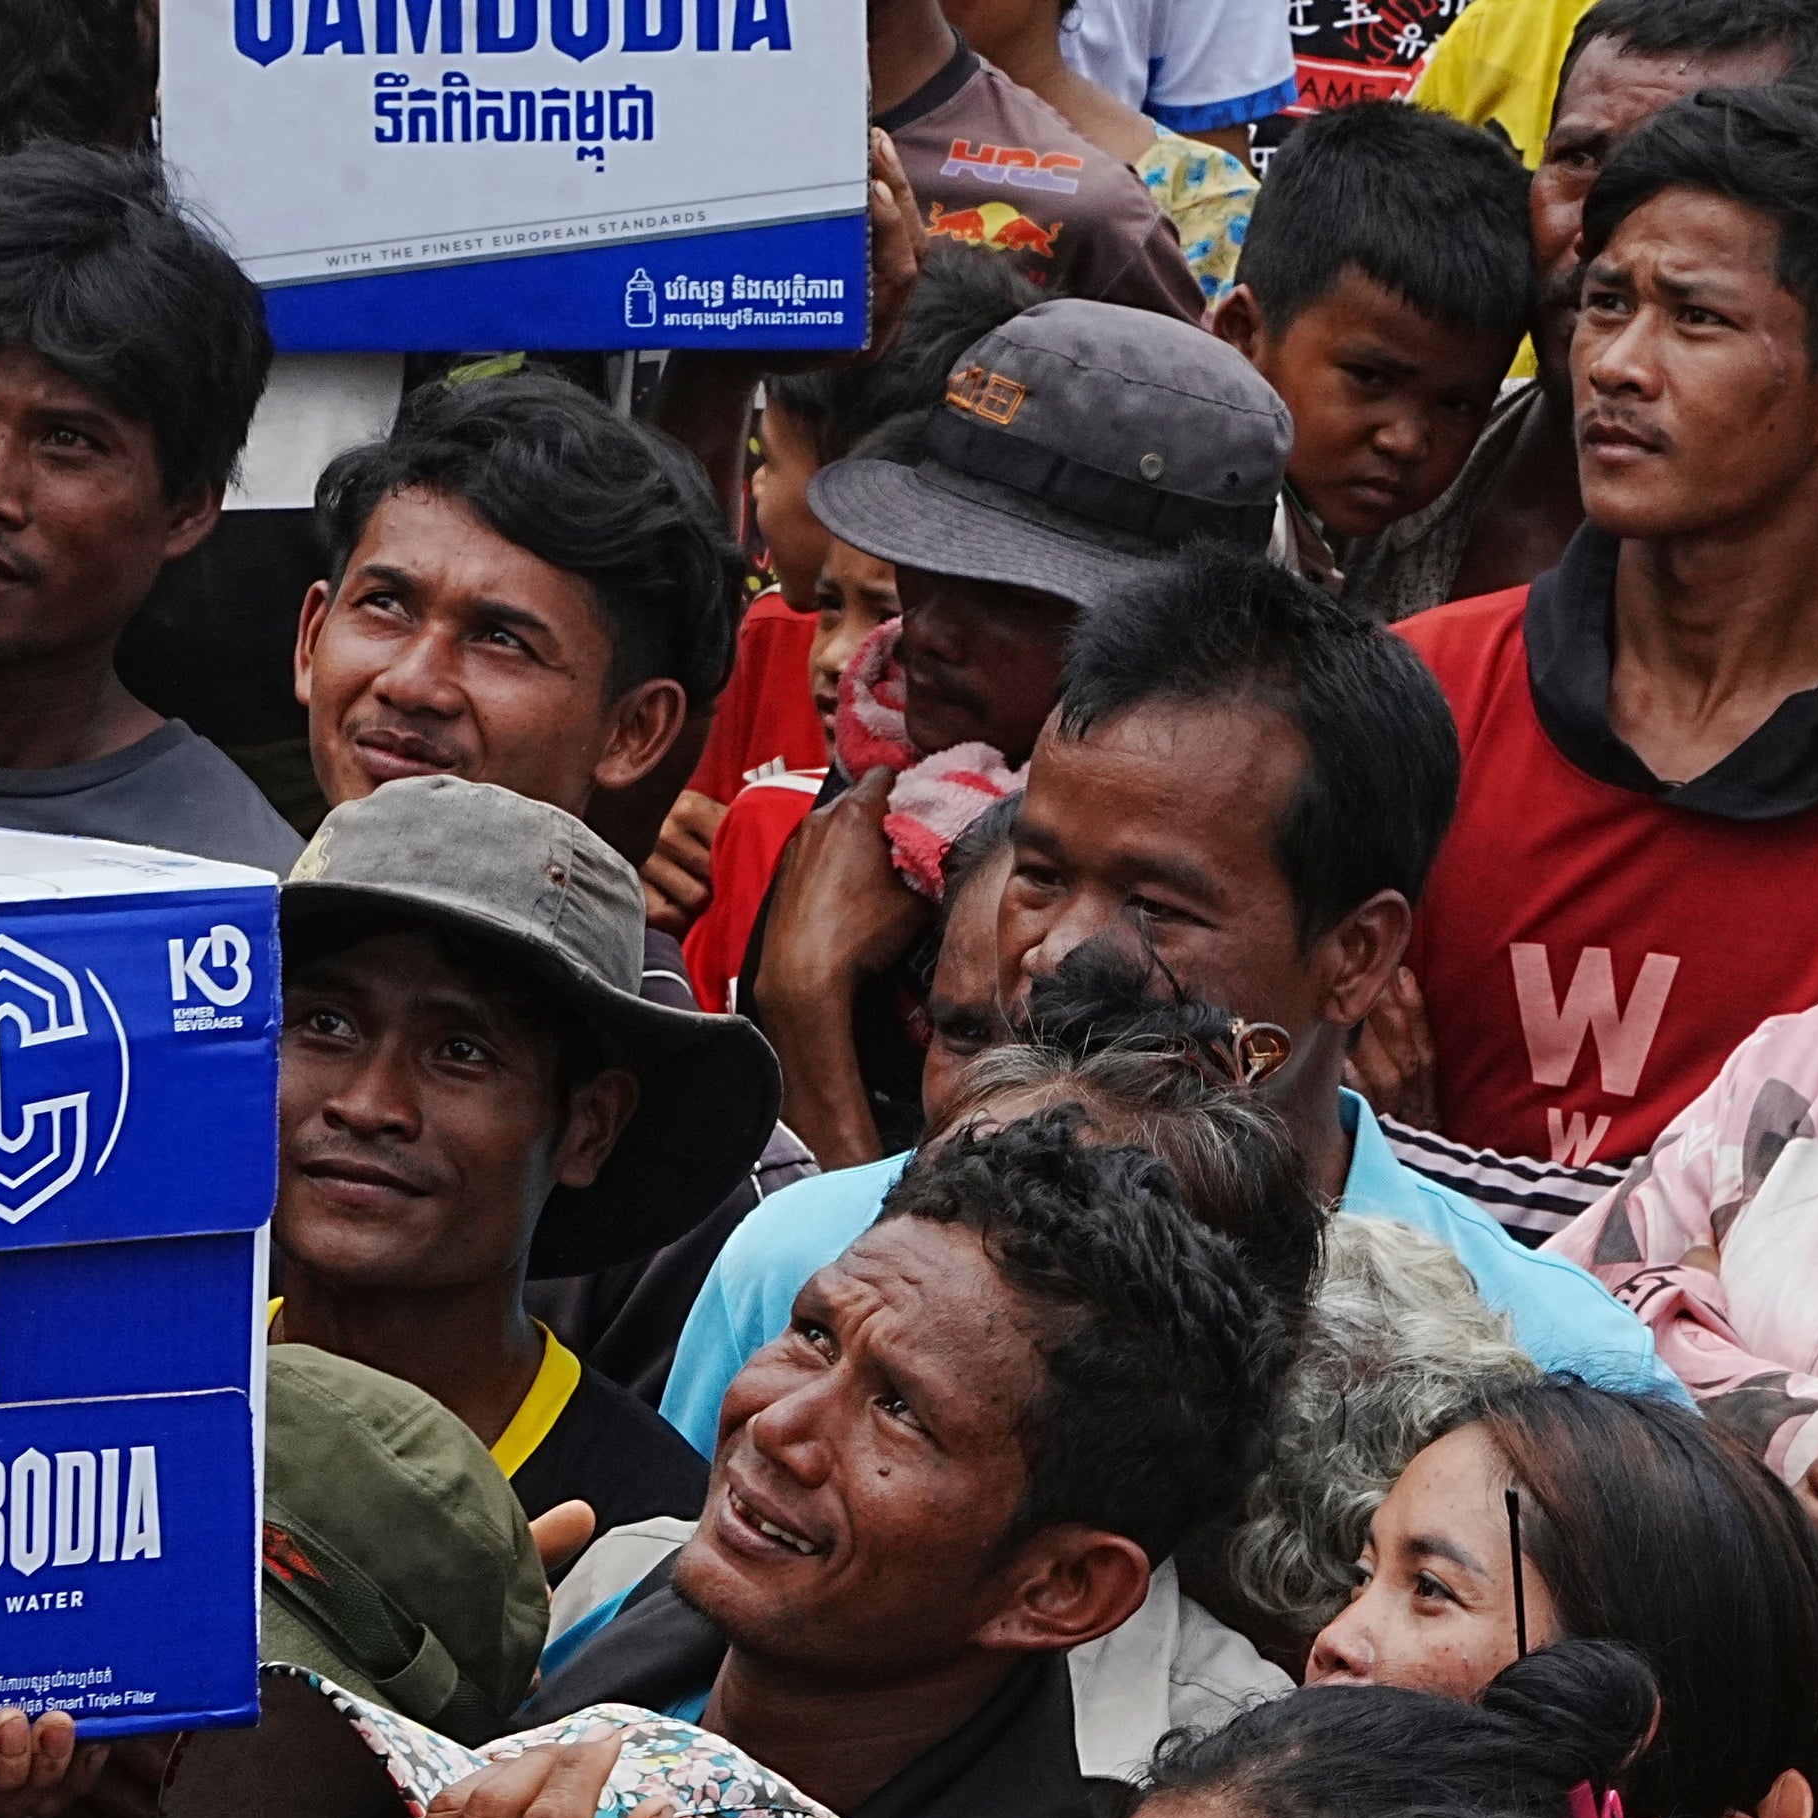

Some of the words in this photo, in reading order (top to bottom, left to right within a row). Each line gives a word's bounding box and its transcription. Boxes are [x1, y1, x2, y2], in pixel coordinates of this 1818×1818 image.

[325, 252, 373, 267] WITH
[380, 246, 414, 261] THE
[421, 238, 484, 256] FINEST
[492, 225, 590, 247] EUROPEAN
[597, 210, 708, 235] STANDARDS
[173, 1006, 215, 1020] KHMER
[174, 1016, 243, 1032] BEVERAGES
[1509, 942, 1681, 1097] W
[5, 1590, 85, 1614] WATER
[45, 1696, 84, 1711] Smart
[86, 1692, 122, 1710] Triple
[124, 1690, 157, 1705] Filter
